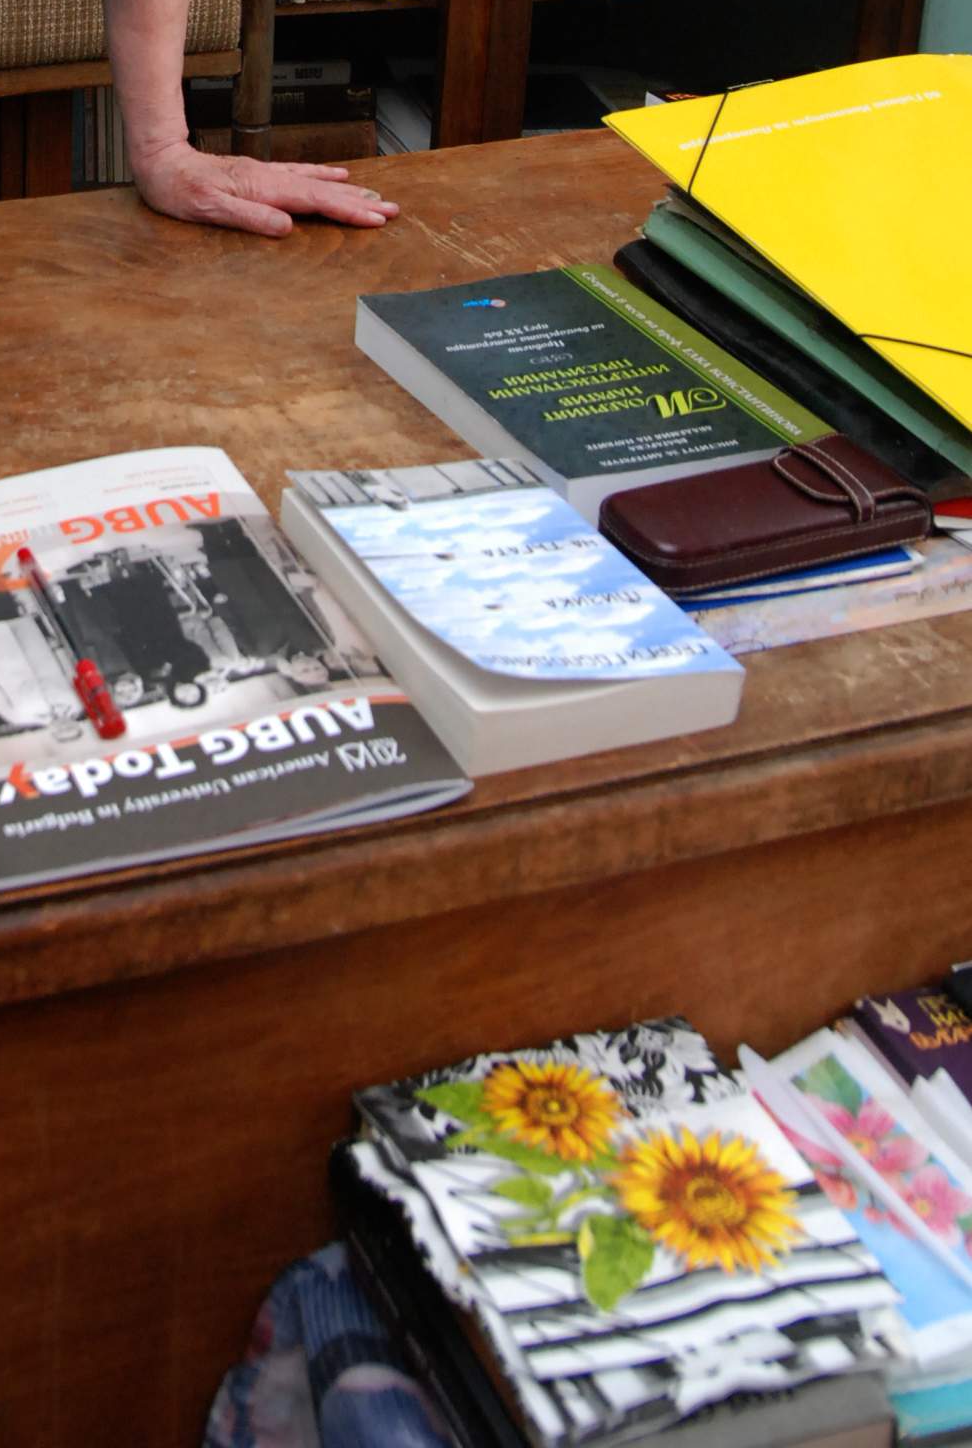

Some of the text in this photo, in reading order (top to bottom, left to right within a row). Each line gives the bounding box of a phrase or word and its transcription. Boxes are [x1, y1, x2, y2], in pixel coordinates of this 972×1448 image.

[484, 322, 549, 339] през век
[518, 324, 590, 343] българската
[445, 336, 516, 352] литература
[509, 338, 566, 354] Проблеми
[488, 362, 670, 399] ИНТЕРТЕКСТУАЛНИ
[503, 358, 634, 386] ПРЕСИЧАНИЯ
[559, 384, 644, 407] НАРАТИВ
[682, 346, 712, 369] ЕЛКА
[709, 364, 803, 436] КОНСТАНТИНОВА
[585, 425, 712, 452] АКАДЕМИЯ НА НАУКИТЕ
[628, 437, 688, 453] БЪЛГАРСКА
[683, 439, 739, 456] ИНСТИТУТ
[601, 451, 663, 467] ЛИТЕРАТУРА
[59, 490, 222, 543] AUBG
[480, 538, 600, 559] НА ТЪГАТА
[543, 589, 643, 612] ФИЗИКА
[628, 643, 710, 665] ГЕОРГИ
[201, 696, 377, 763] AUBG
[233, 749, 332, 780] American
[124, 771, 231, 812] University
[3, 802, 95, 839] Bulgaria
[98, 801, 122, 822] in
